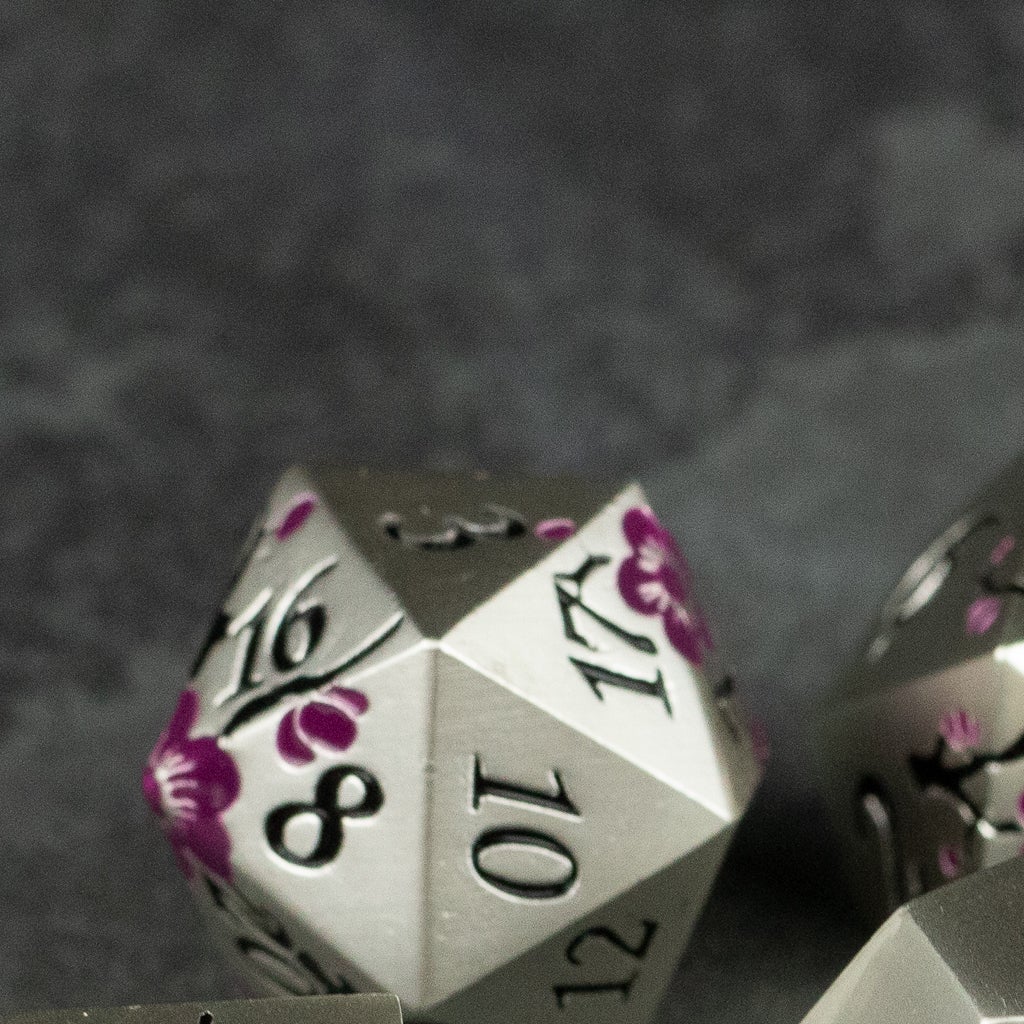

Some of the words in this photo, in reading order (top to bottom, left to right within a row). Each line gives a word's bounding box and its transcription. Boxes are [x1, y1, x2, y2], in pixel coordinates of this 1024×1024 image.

[213, 555, 340, 706] 16
[553, 553, 676, 718] 17
[264, 764, 386, 872] 8
[469, 752, 582, 902] 10
[554, 917, 659, 1010] 12
